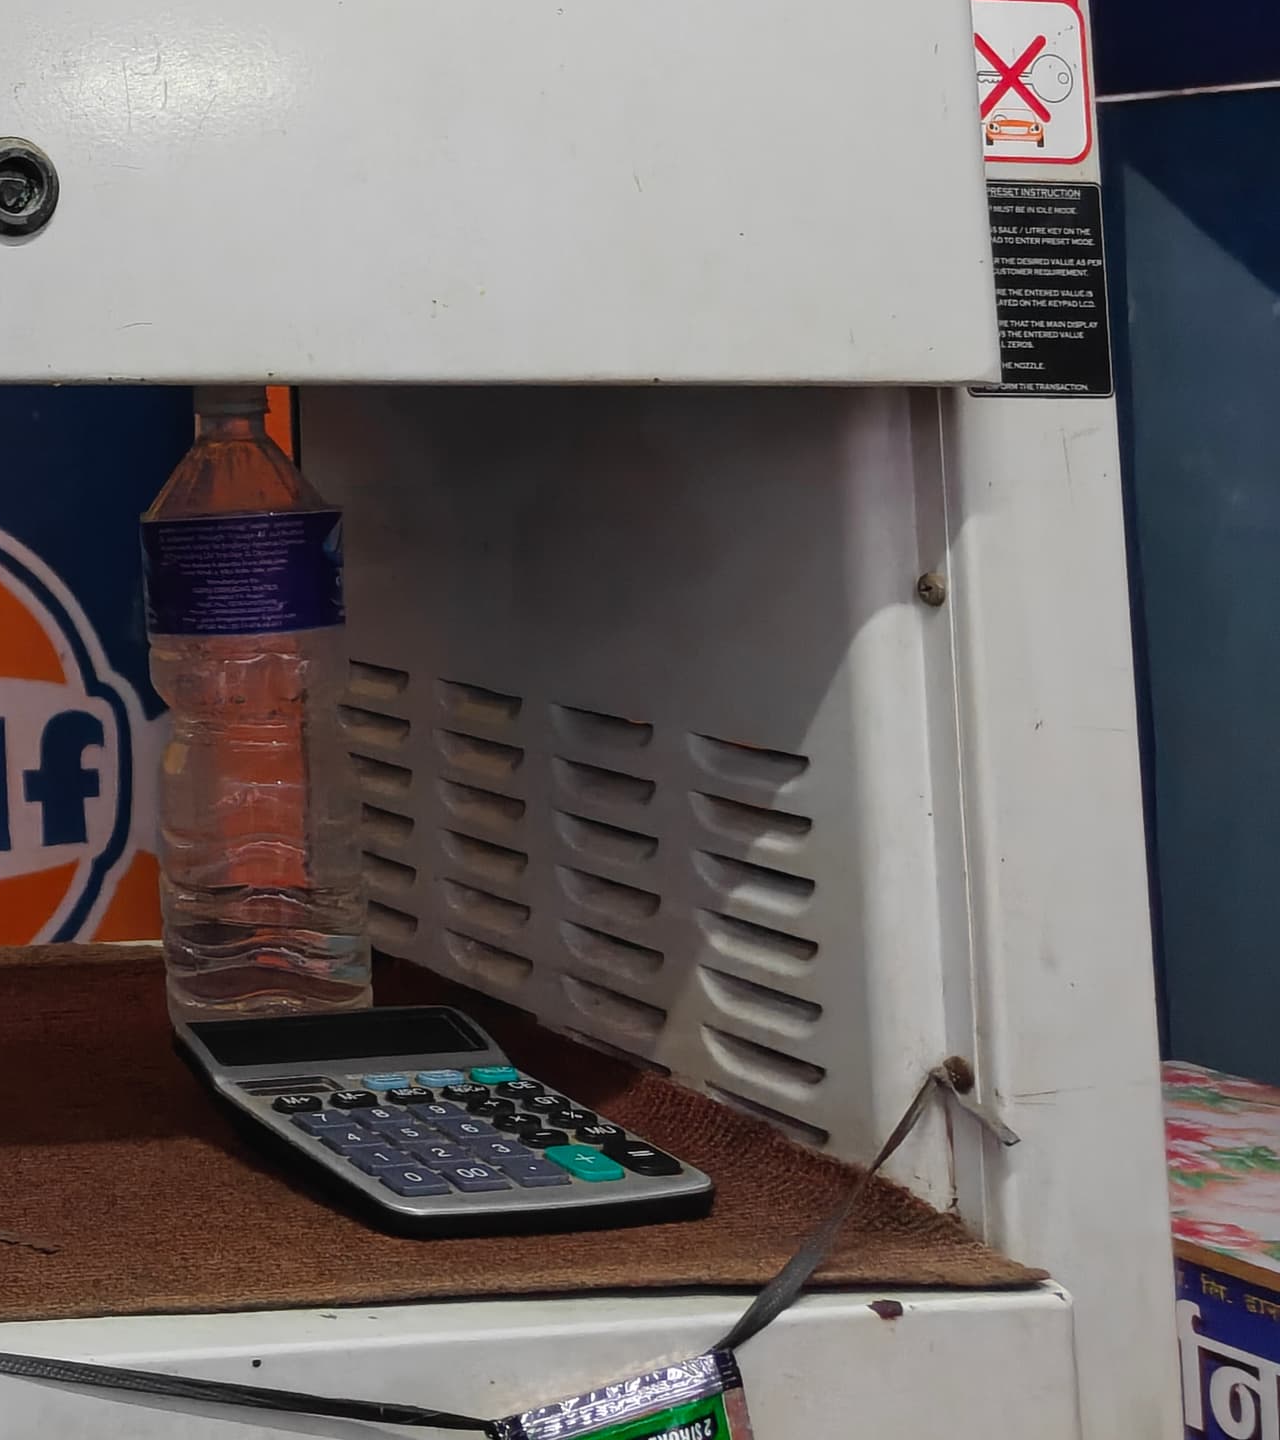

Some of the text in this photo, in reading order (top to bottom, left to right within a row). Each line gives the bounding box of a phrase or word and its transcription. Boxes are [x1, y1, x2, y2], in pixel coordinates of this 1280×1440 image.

[1021, 188, 1081, 199] INSTRUCTION
[508, 1081, 537, 1090] CE
[312, 1113, 328, 1122] 7
[372, 1108, 390, 1118] 8
[347, 1132, 361, 1142] 4
[400, 1127, 419, 1138] 5
[460, 1123, 480, 1134] 6
[374, 1152, 390, 1161] 1
[431, 1147, 452, 1158] 2
[491, 1143, 511, 1153] 3
[403, 1172, 423, 1182] 0
[456, 1167, 489, 1179] 00
